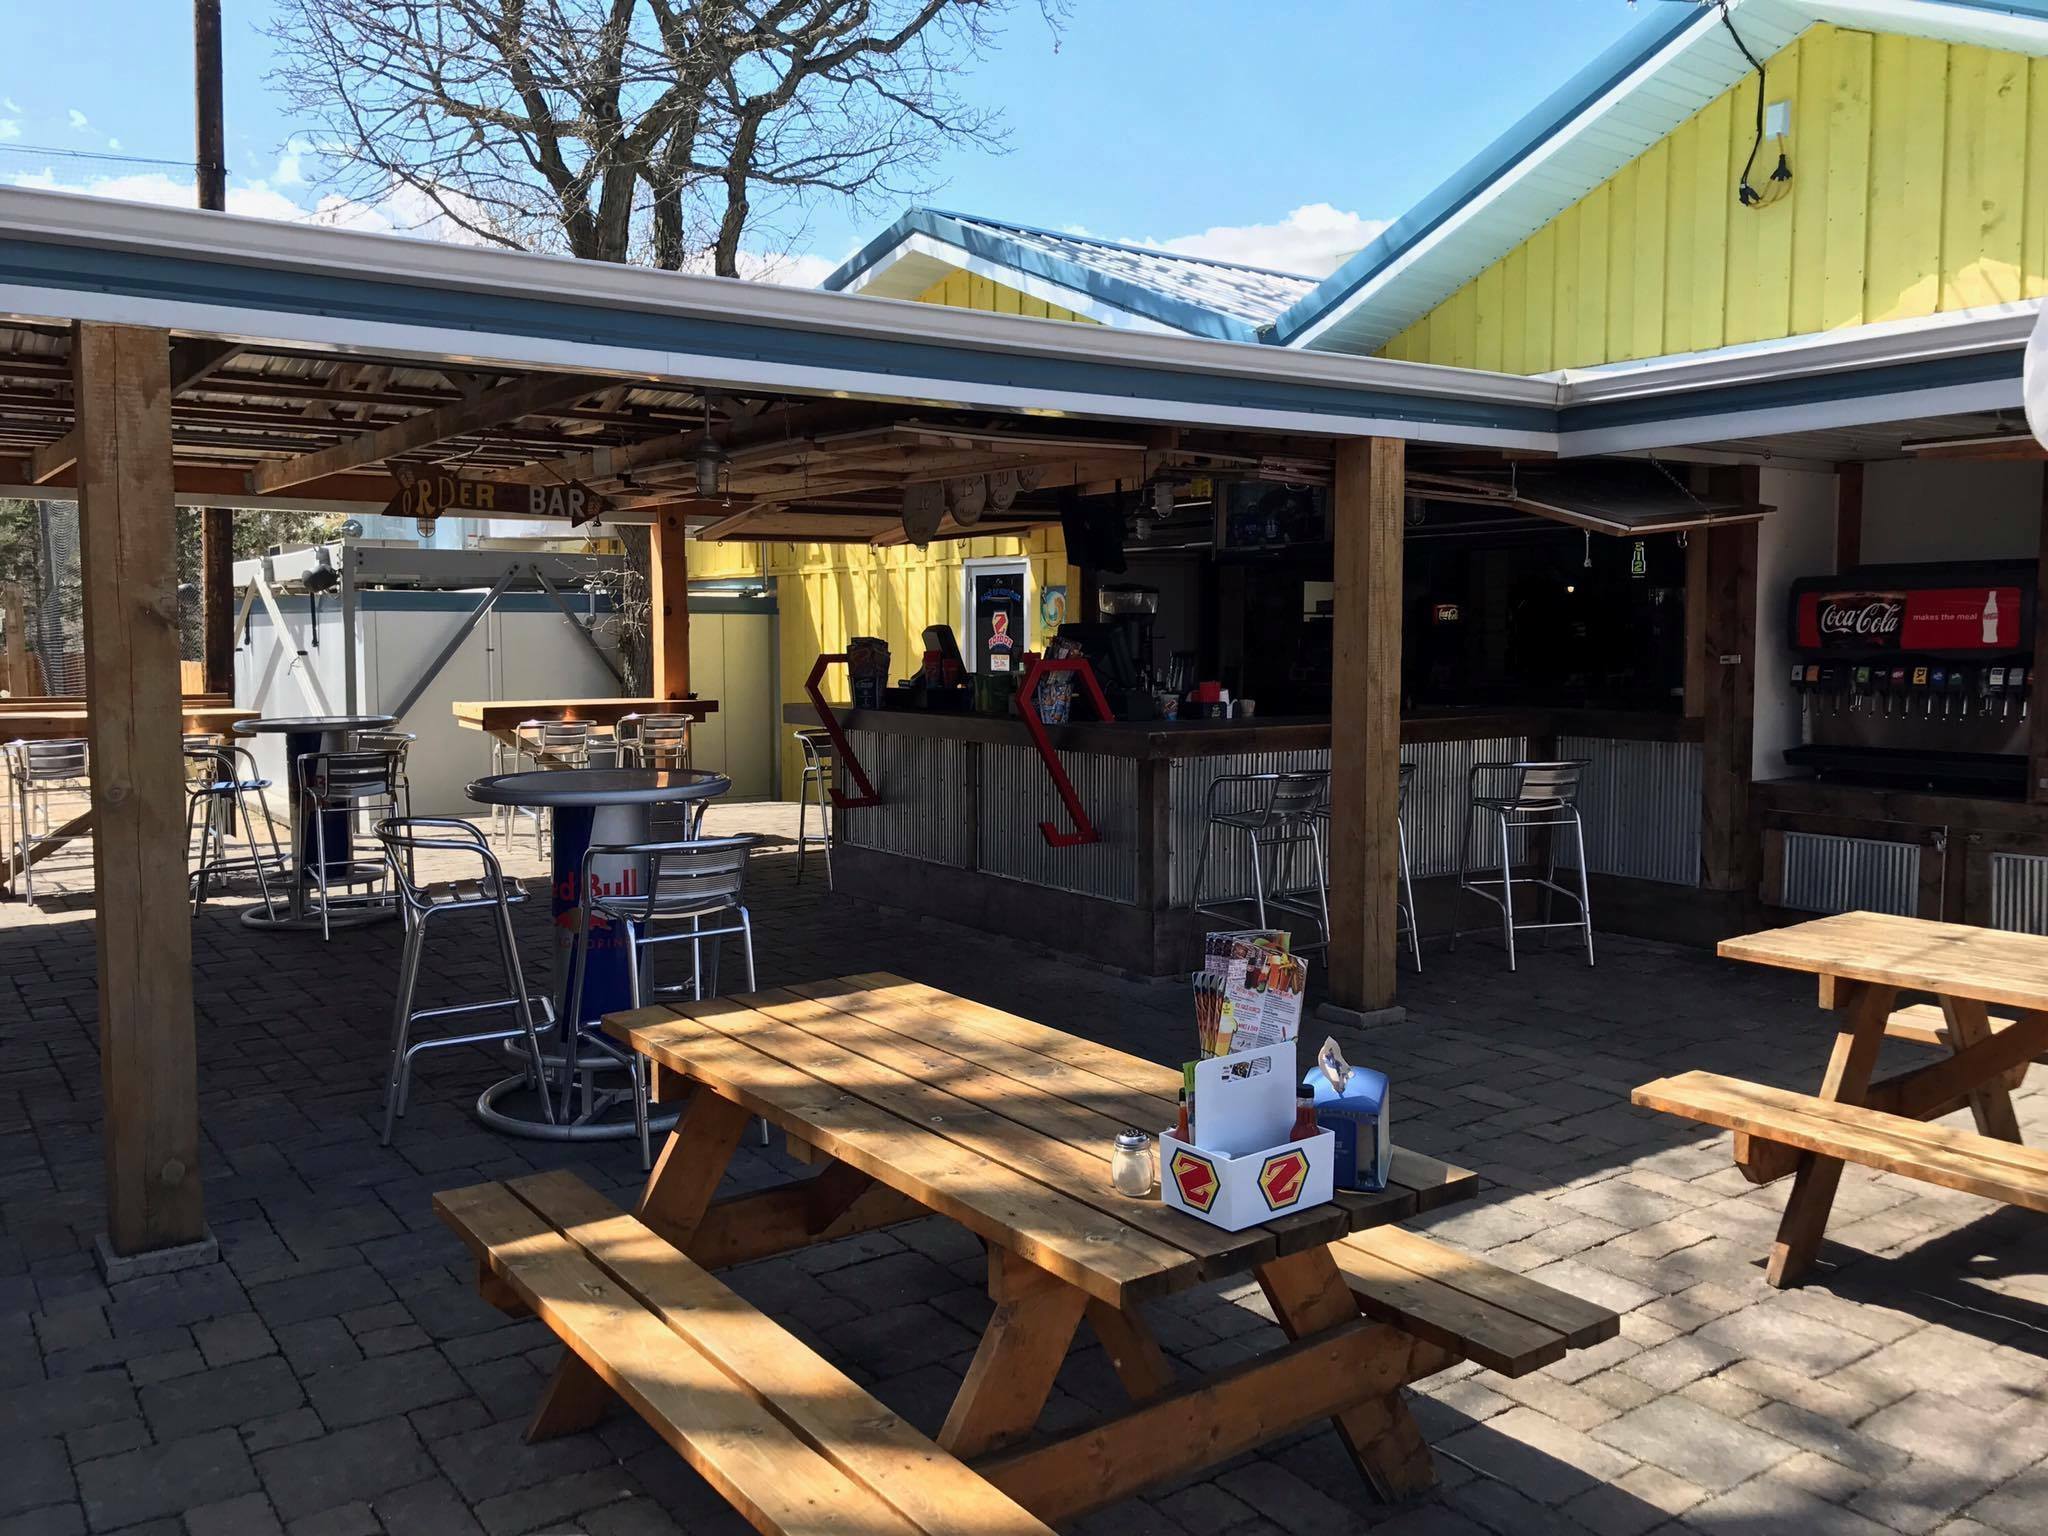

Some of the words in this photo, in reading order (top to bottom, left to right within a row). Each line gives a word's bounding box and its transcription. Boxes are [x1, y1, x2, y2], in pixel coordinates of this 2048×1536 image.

[402, 476, 495, 515] ORDER
[530, 485, 586, 518] BAR
[1820, 602, 1902, 634] Coca-Cola
[1912, 613, 1939, 621] makes
[1941, 612, 1954, 621] the
[1956, 612, 1978, 621] meal
[1178, 1156, 1213, 1205] Z
[1266, 1155, 1303, 1204] Z
